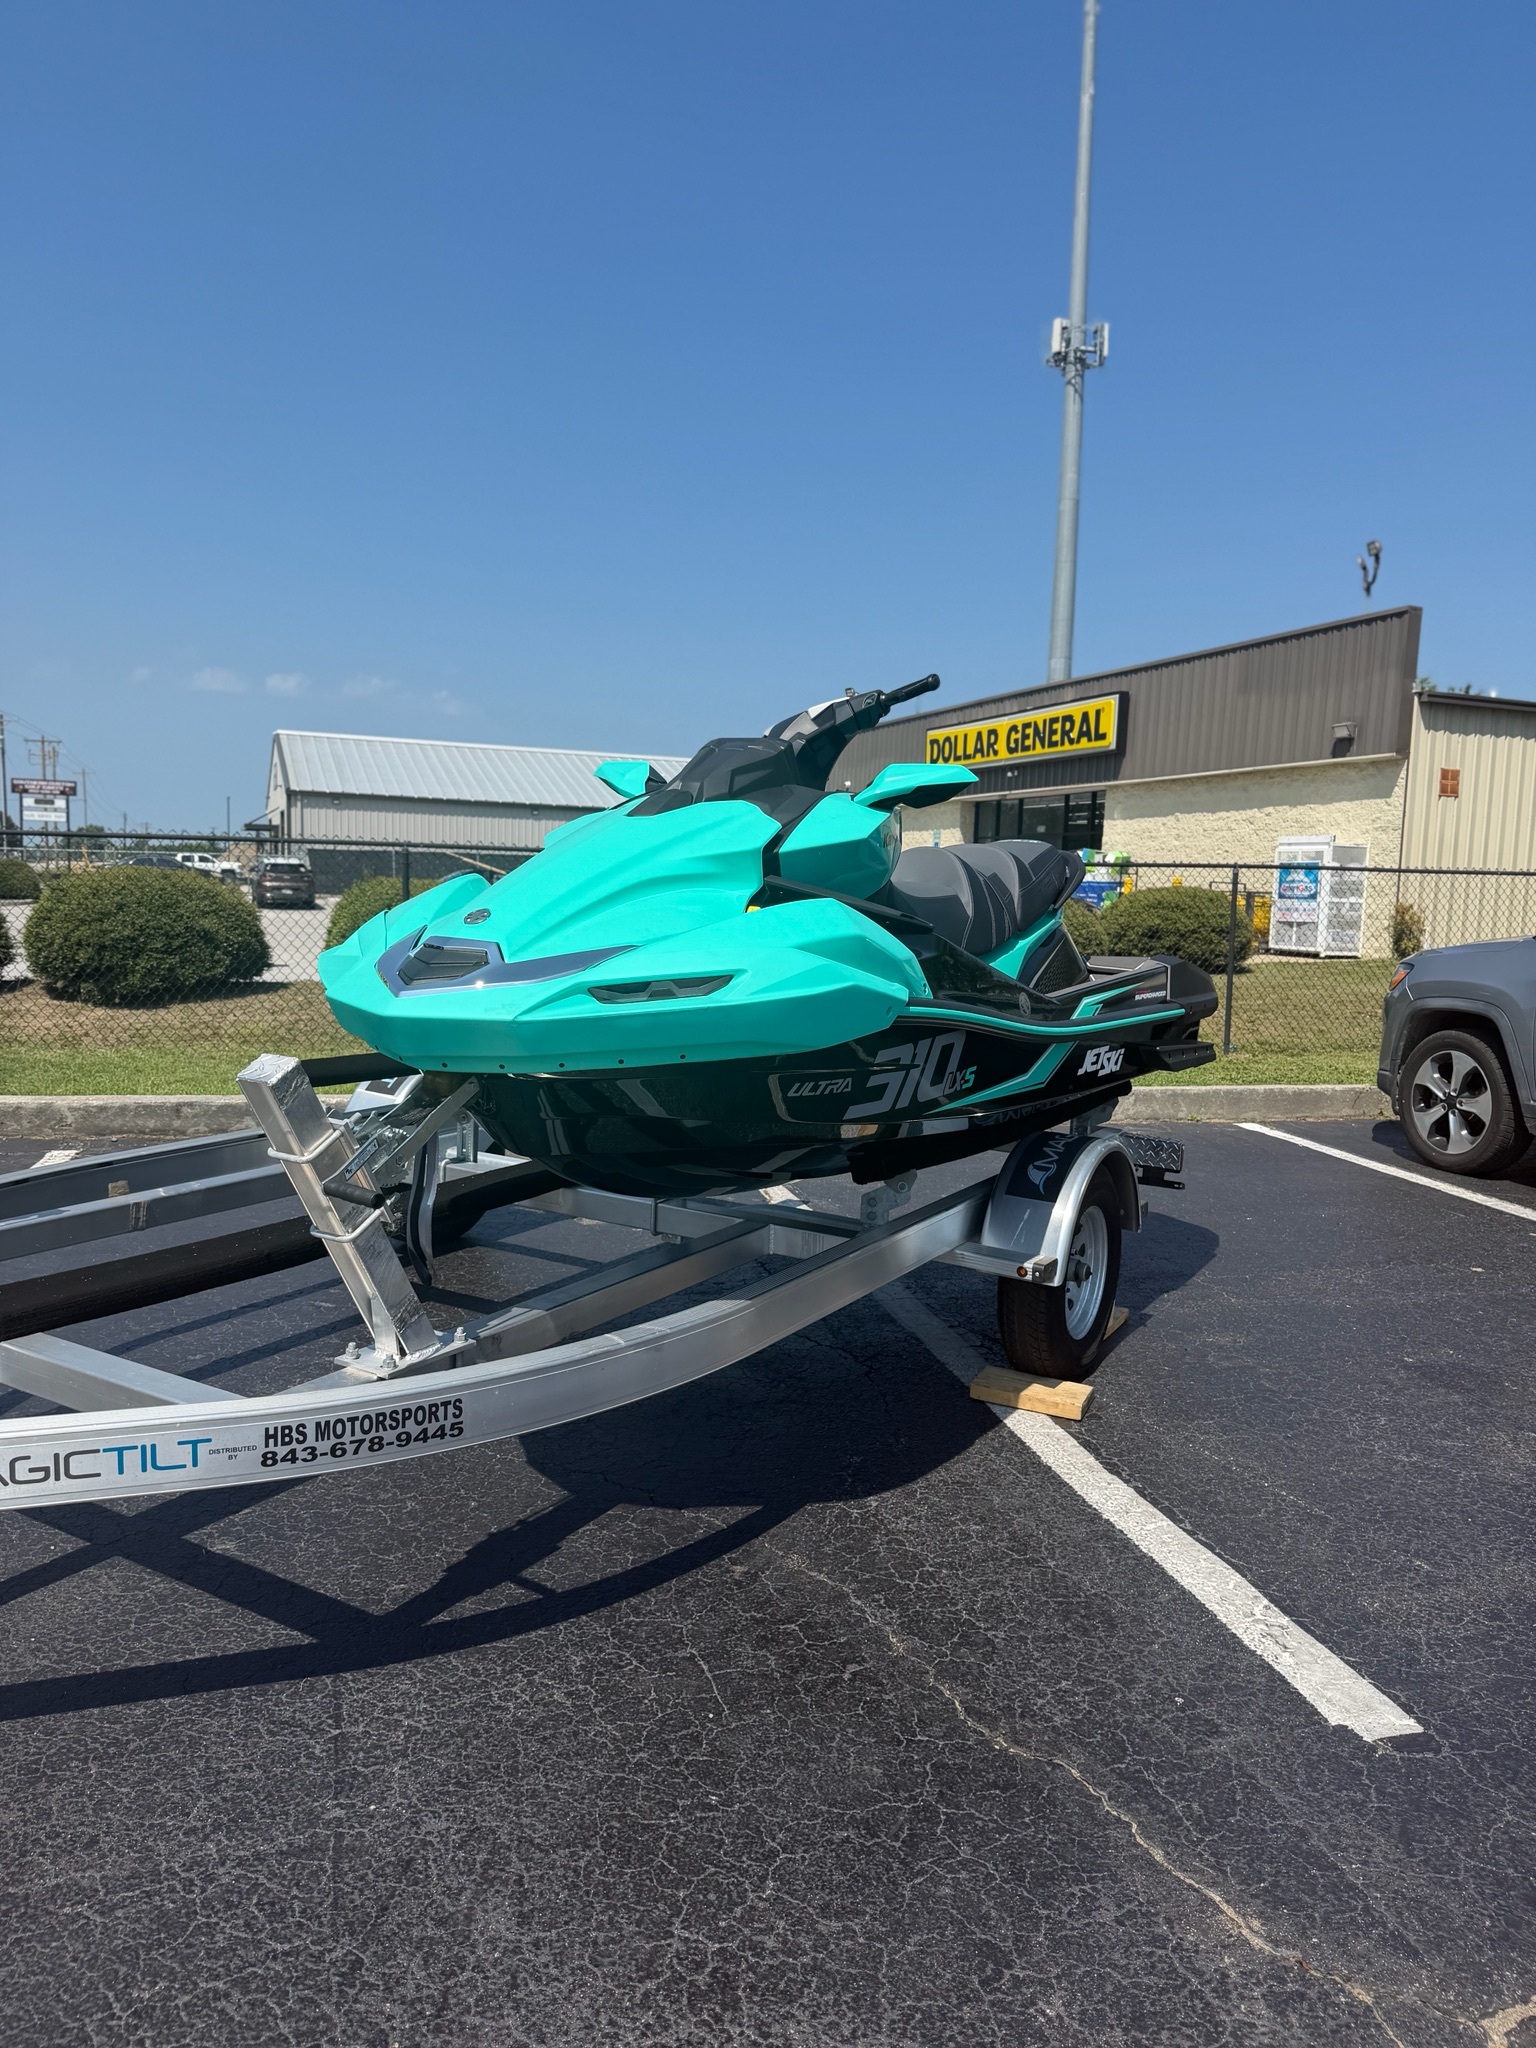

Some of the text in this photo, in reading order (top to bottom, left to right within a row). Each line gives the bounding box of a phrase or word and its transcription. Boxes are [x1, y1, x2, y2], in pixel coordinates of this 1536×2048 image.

[929, 708, 1108, 764] DOLLAR GENERAL
[786, 1077, 853, 1097] ULTRA
[842, 1029, 966, 1120] 310
[260, 1421, 464, 1468] 843-678-9445
[264, 1398, 463, 1449] HBS MOTORSPORTS
[0, 1438, 213, 1487] GICTILT
[208, 1444, 258, 1456] DISTRIBUTED
[228, 1453, 239, 1461] BY
